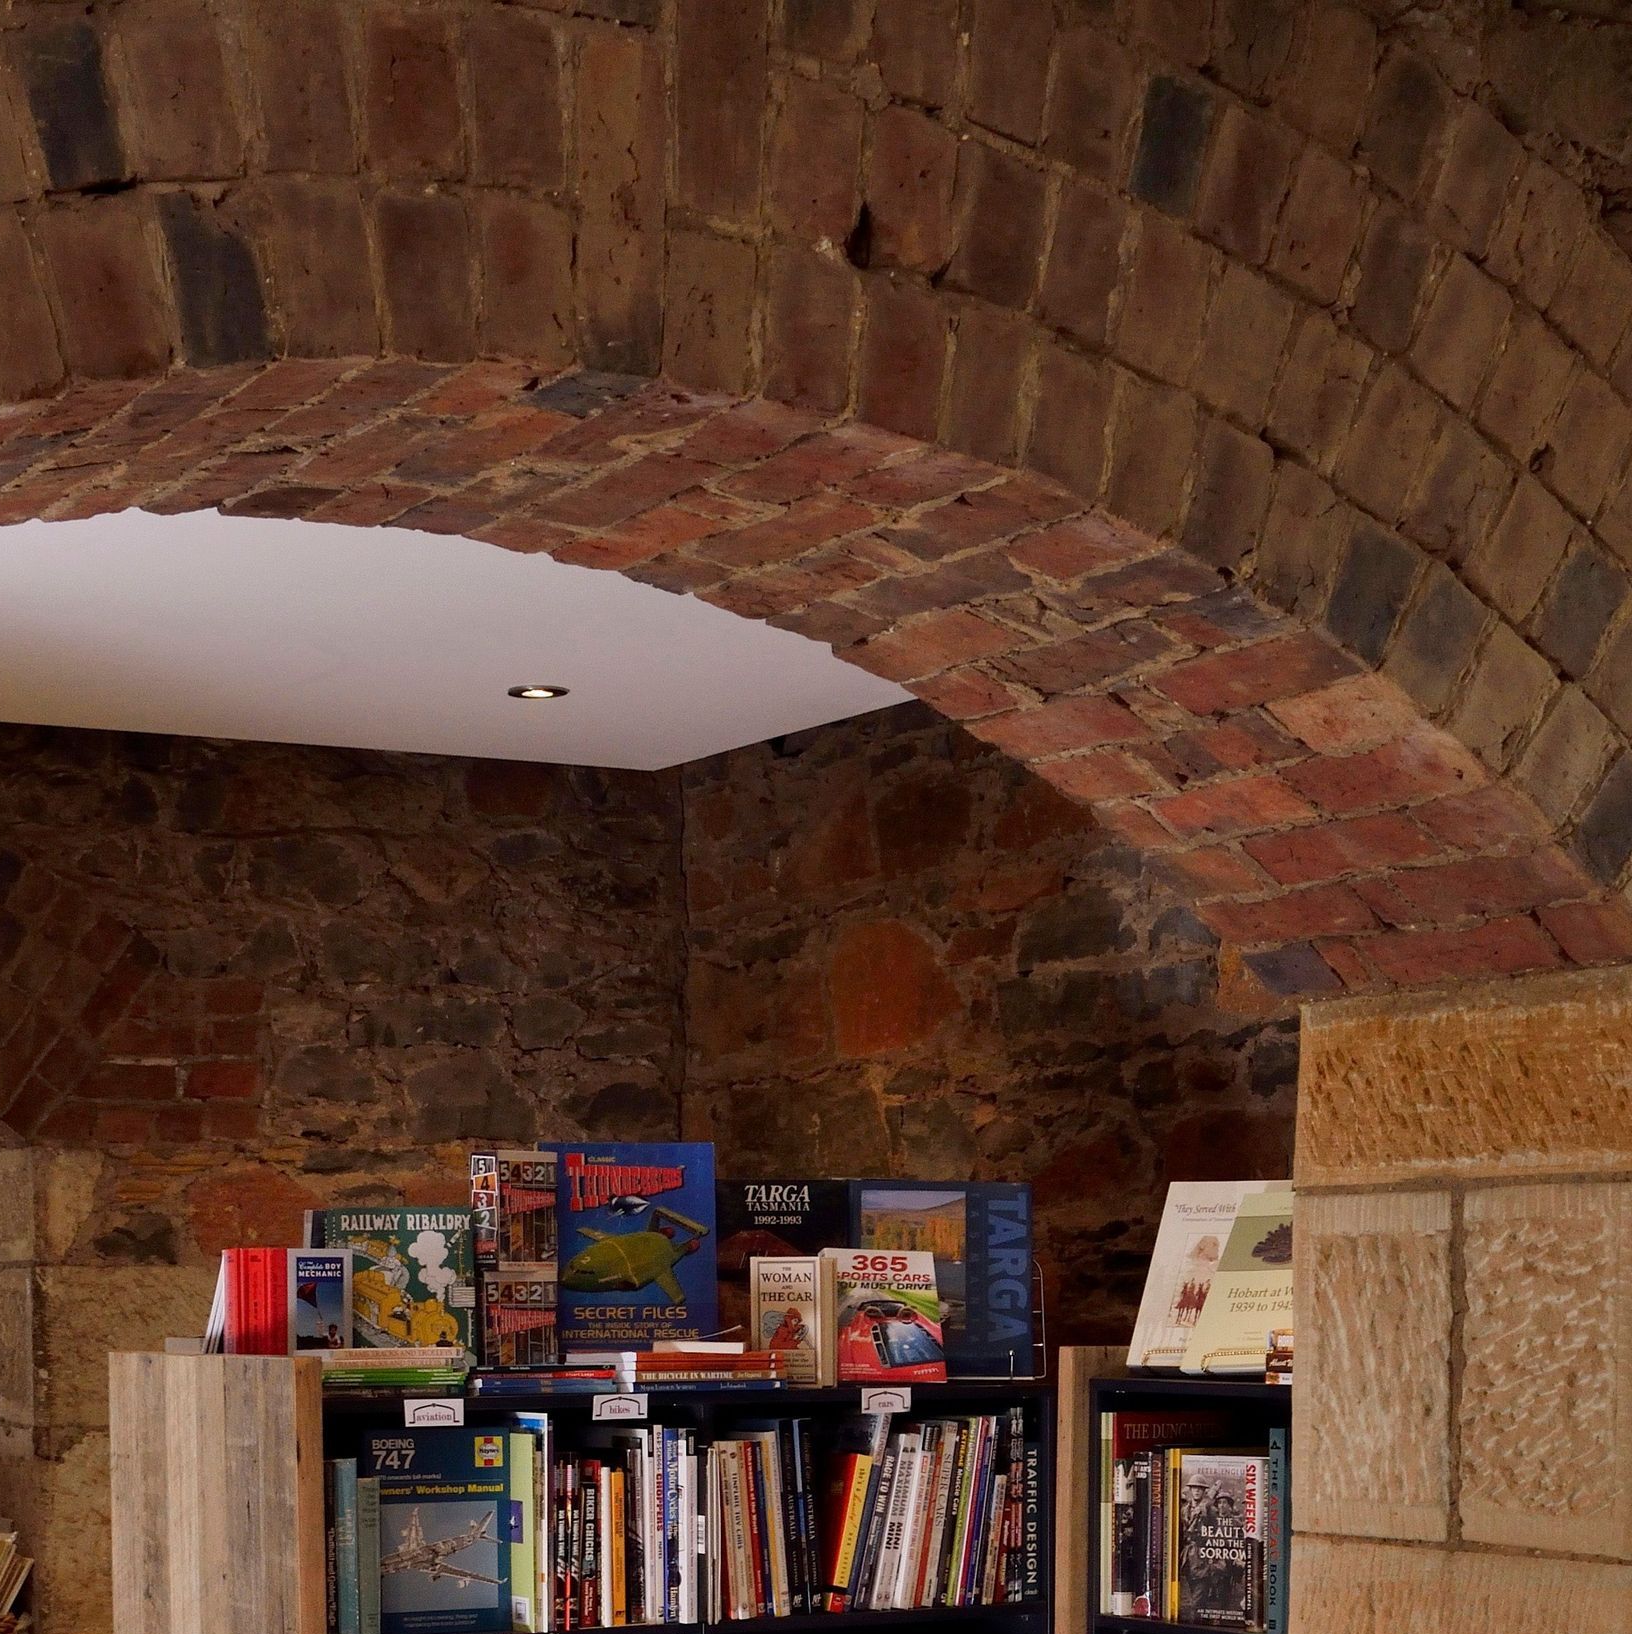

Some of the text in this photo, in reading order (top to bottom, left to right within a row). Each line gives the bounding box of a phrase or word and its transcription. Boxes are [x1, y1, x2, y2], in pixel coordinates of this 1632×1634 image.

[744, 1185, 810, 1201] TARGA
[747, 1203, 810, 1211] TASMANIA
[341, 1214, 471, 1230] RAILWAY RIBALDRY
[754, 1216, 801, 1225] 1992-1993
[852, 1255, 908, 1272] 365
[987, 1192, 1028, 1341] TARGA
[761, 1273, 812, 1283] WOMAN
[893, 1273, 930, 1282] CARS
[761, 1291, 813, 1301] THE CAR
[1229, 1288, 1261, 1299] Hobart
[574, 1307, 687, 1319] SECRET FILES
[563, 1329, 698, 1338] INTERNATIONAL RESCUE
[609, 1404, 630, 1415] bikes
[417, 1413, 453, 1421] aviation
[372, 1439, 414, 1449] BOEING
[373, 1451, 416, 1469] 747
[380, 1484, 503, 1495] wners' Workshop Manual
[1246, 1465, 1255, 1533] SIX WEEKS
[1028, 1450, 1037, 1583] TRAFFIC DESIGN
[1217, 1517, 1232, 1525] THE
[586, 1488, 594, 1560] BIKER CHICKS
[1270, 1496, 1280, 1557] ANZAC
[1201, 1525, 1246, 1537] BEAUTY
[1205, 1539, 1244, 1548] AND THE
[1200, 1548, 1247, 1560] SORROW
